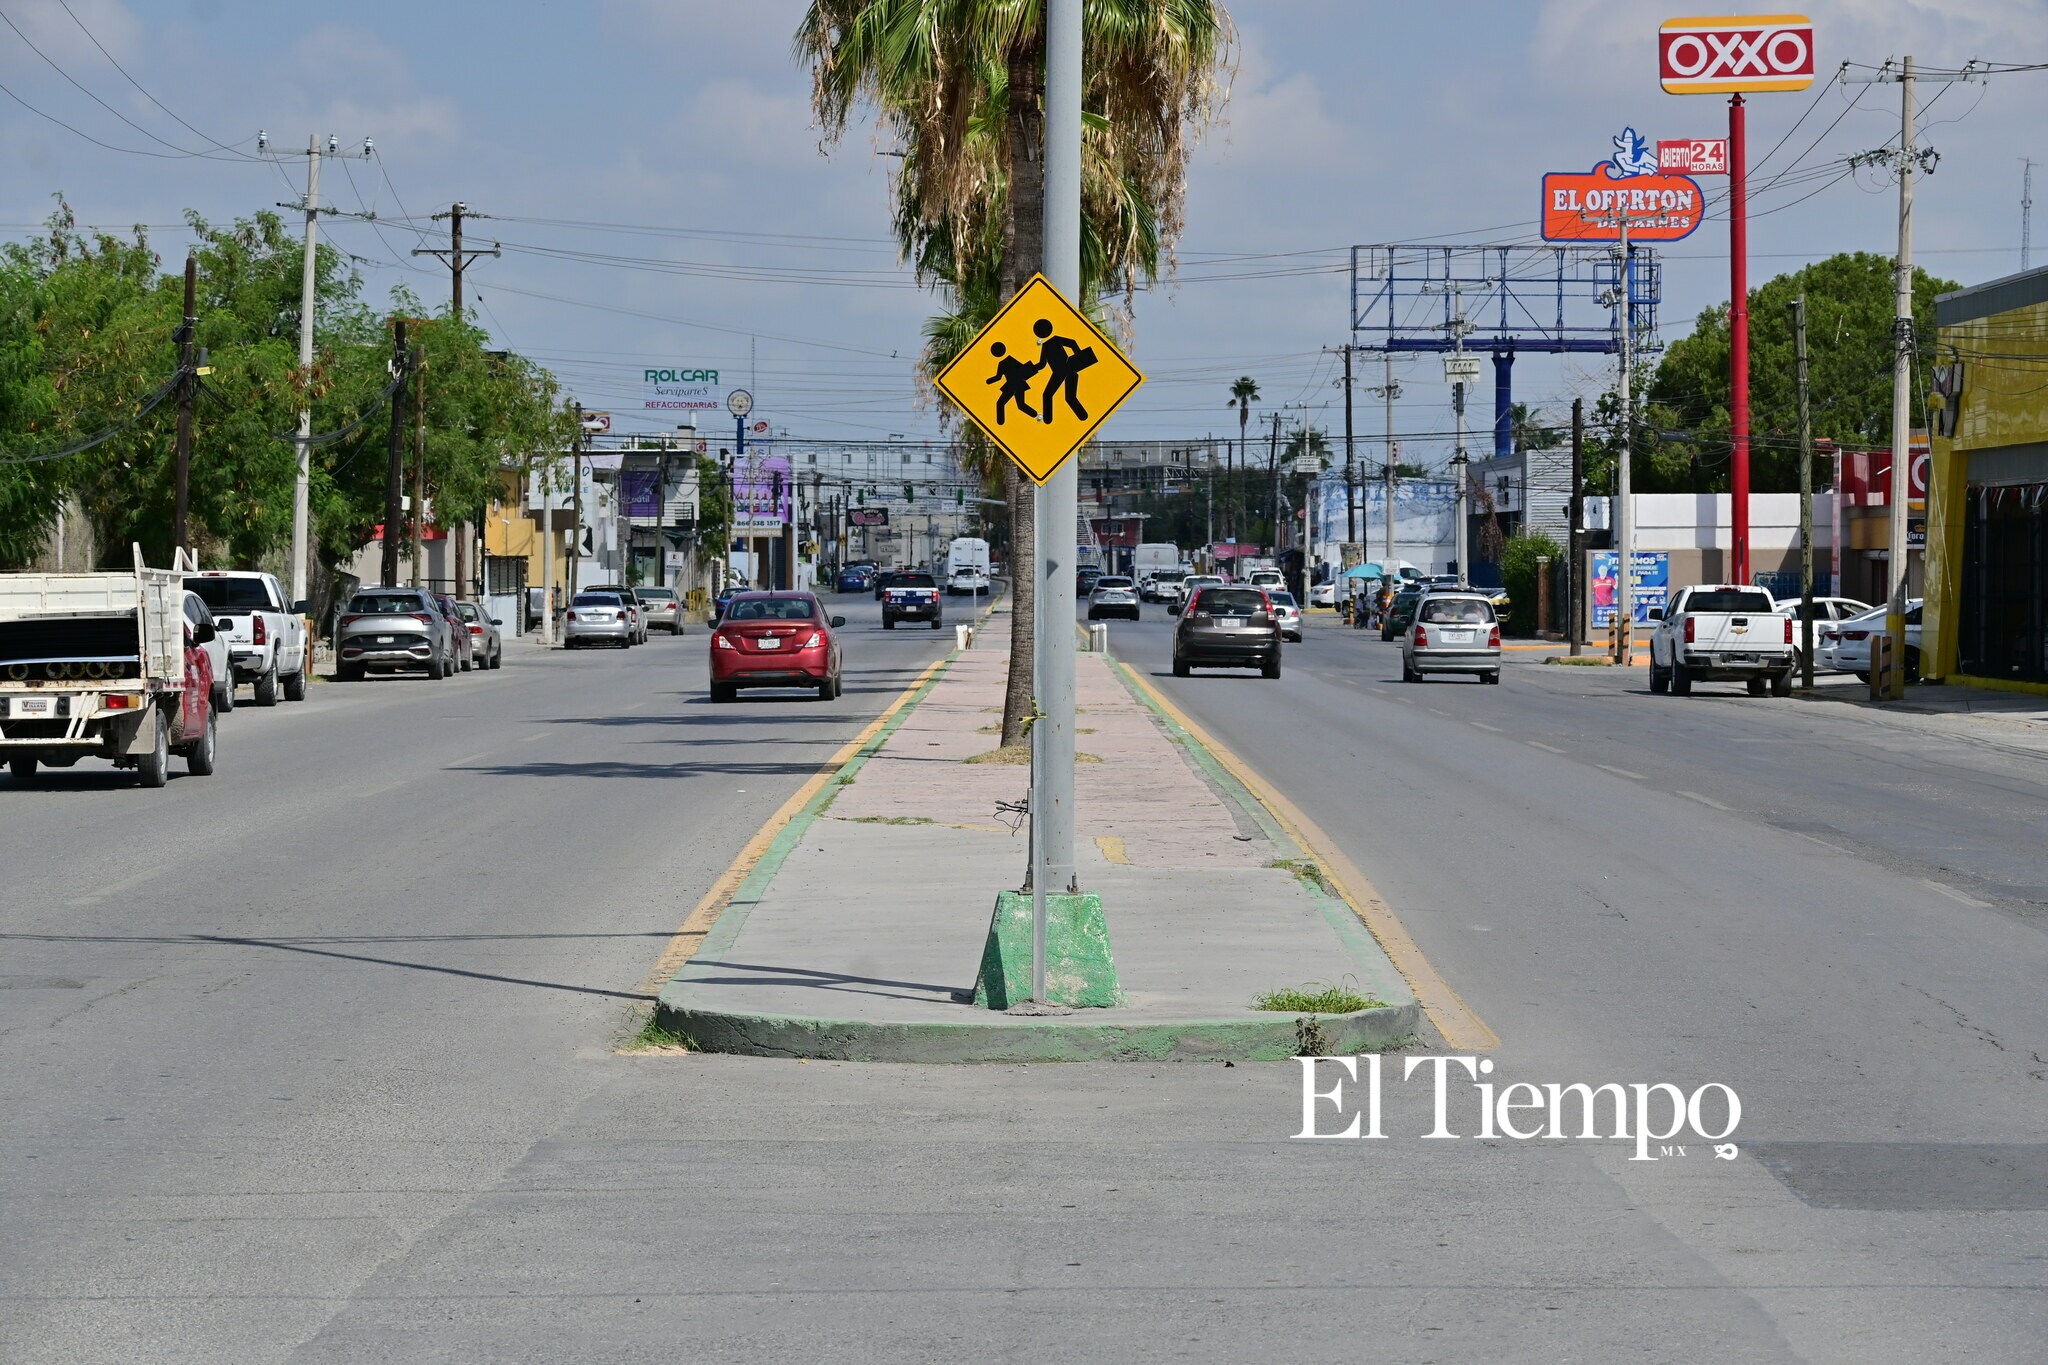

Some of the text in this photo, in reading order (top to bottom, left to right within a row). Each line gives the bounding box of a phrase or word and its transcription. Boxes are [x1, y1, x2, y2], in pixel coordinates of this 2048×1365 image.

[1667, 31, 1807, 76] OXXO
[1659, 147, 1690, 168] ABIERTO
[1691, 142, 1723, 162] 24
[1691, 163, 1723, 171] HORAS
[1553, 188, 1694, 211] EL OFERTON
[645, 369, 719, 385] ROLCAR
[655, 386, 709, 397] ServiparteS
[645, 401, 718, 409] REFACCIONARIAS
[1460, 573, 1466, 583] 6
